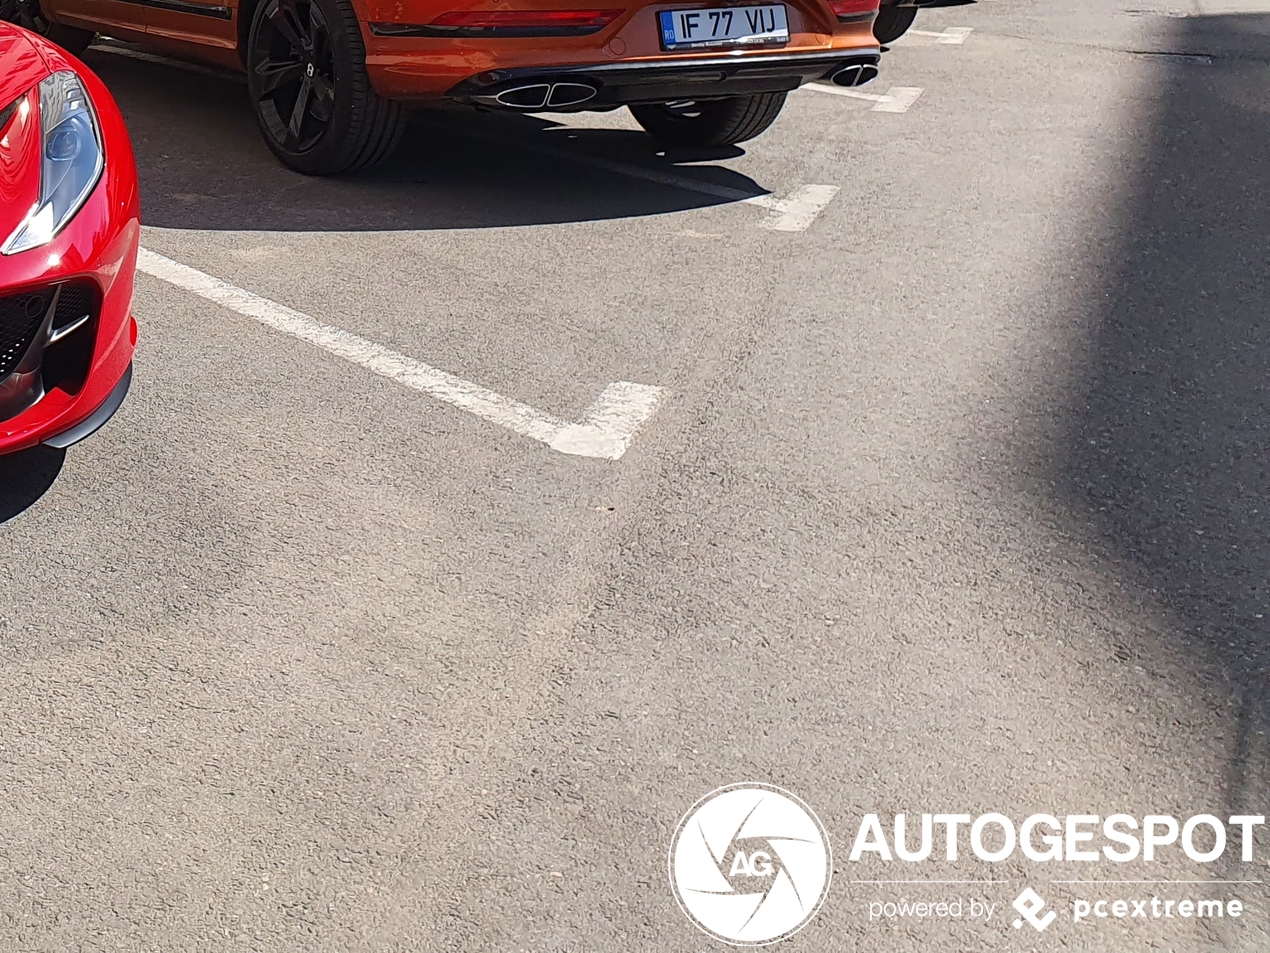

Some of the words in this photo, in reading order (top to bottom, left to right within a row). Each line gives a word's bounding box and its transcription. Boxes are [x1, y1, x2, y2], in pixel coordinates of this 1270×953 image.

[680, 13, 700, 39] IF
[708, 11, 733, 36] 77
[744, 8, 775, 34] VIJ
[664, 29, 675, 40] RO
